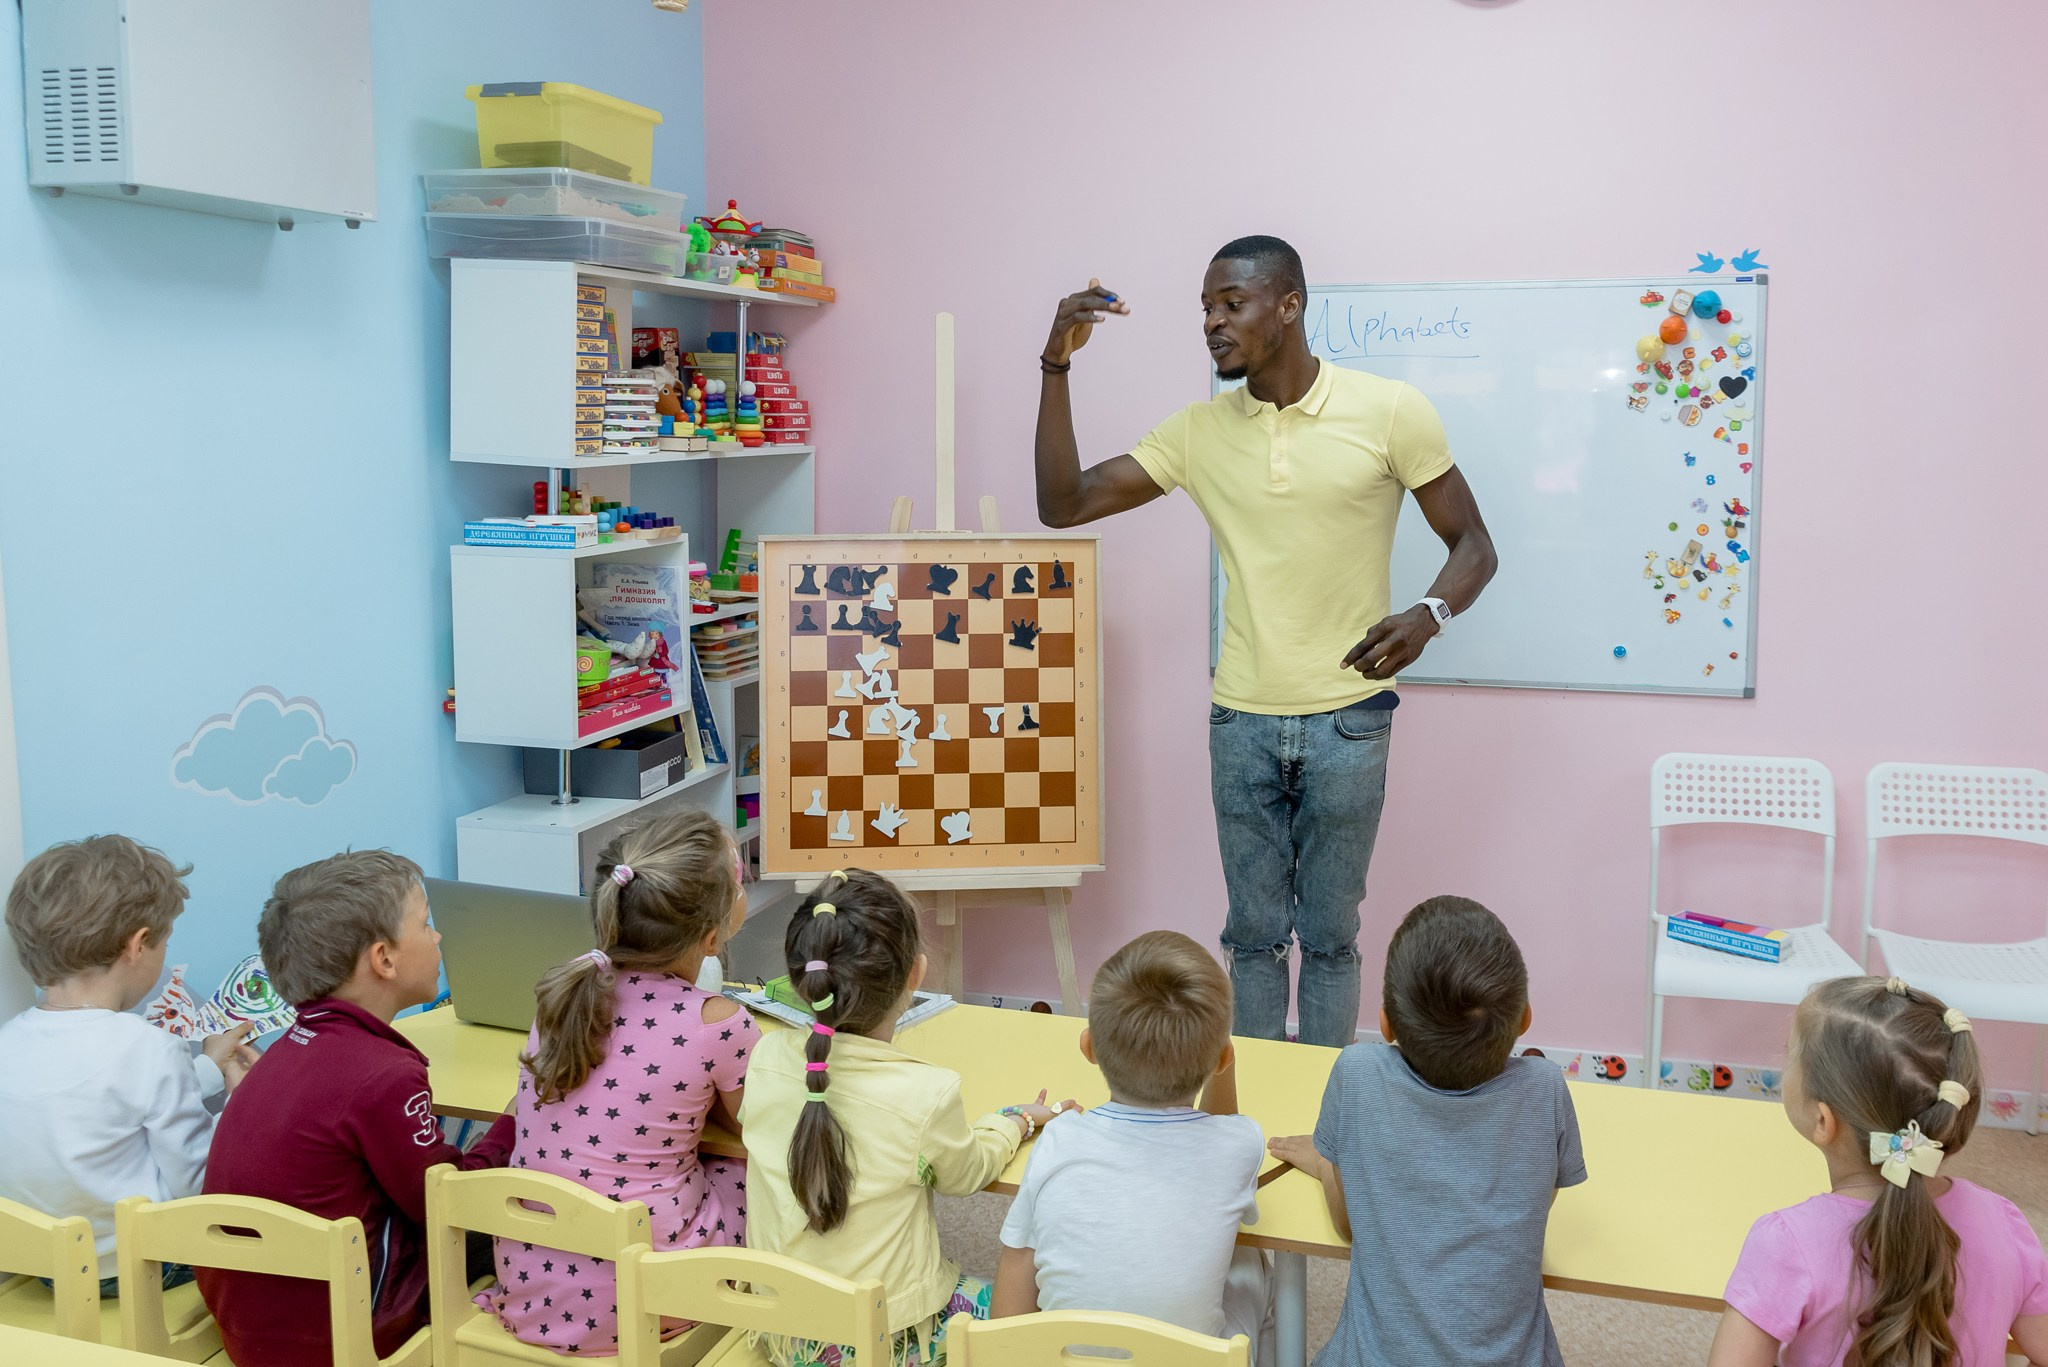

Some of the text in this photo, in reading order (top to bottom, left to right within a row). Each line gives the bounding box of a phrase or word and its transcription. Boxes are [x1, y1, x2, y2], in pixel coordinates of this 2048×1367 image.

[1307, 299, 1472, 356] Alphabets
[1706, 474, 1716, 486] 8
[470, 530, 570, 541] ДЕРЕВЯННЫЕ ИГРУШКИ
[616, 586, 656, 595] Гимназия
[625, 596, 666, 604] дошколят
[1672, 925, 1774, 954] ДЕРЕВЯННЫЕ ИГРУШКИ
[404, 1090, 437, 1146] 3
